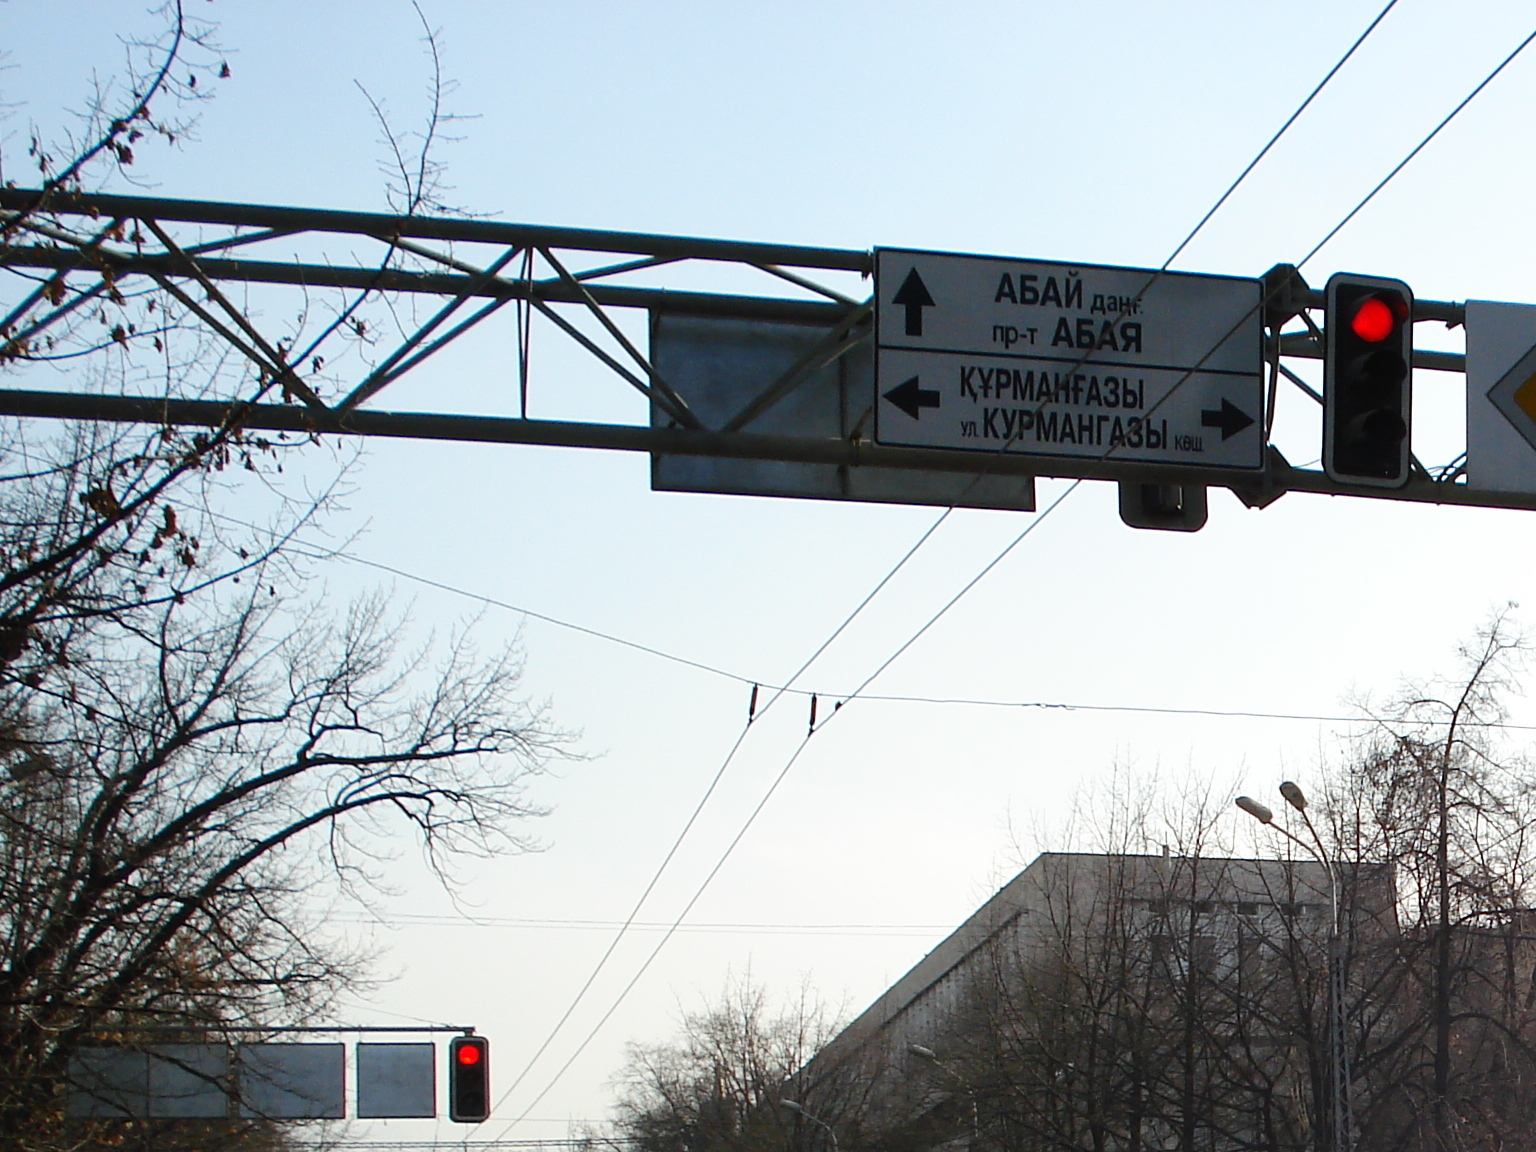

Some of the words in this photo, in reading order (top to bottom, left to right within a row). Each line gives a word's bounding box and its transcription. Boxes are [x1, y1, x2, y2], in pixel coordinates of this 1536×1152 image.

[994, 271, 1083, 309] АБАЙ
[992, 324, 1037, 348] пр-т
[1051, 317, 1142, 353] АБАЯ
[960, 365, 1144, 410] ҚҰРМАНҒАЗЫ
[983, 407, 1168, 450] КУРМАНГАЗЫ
